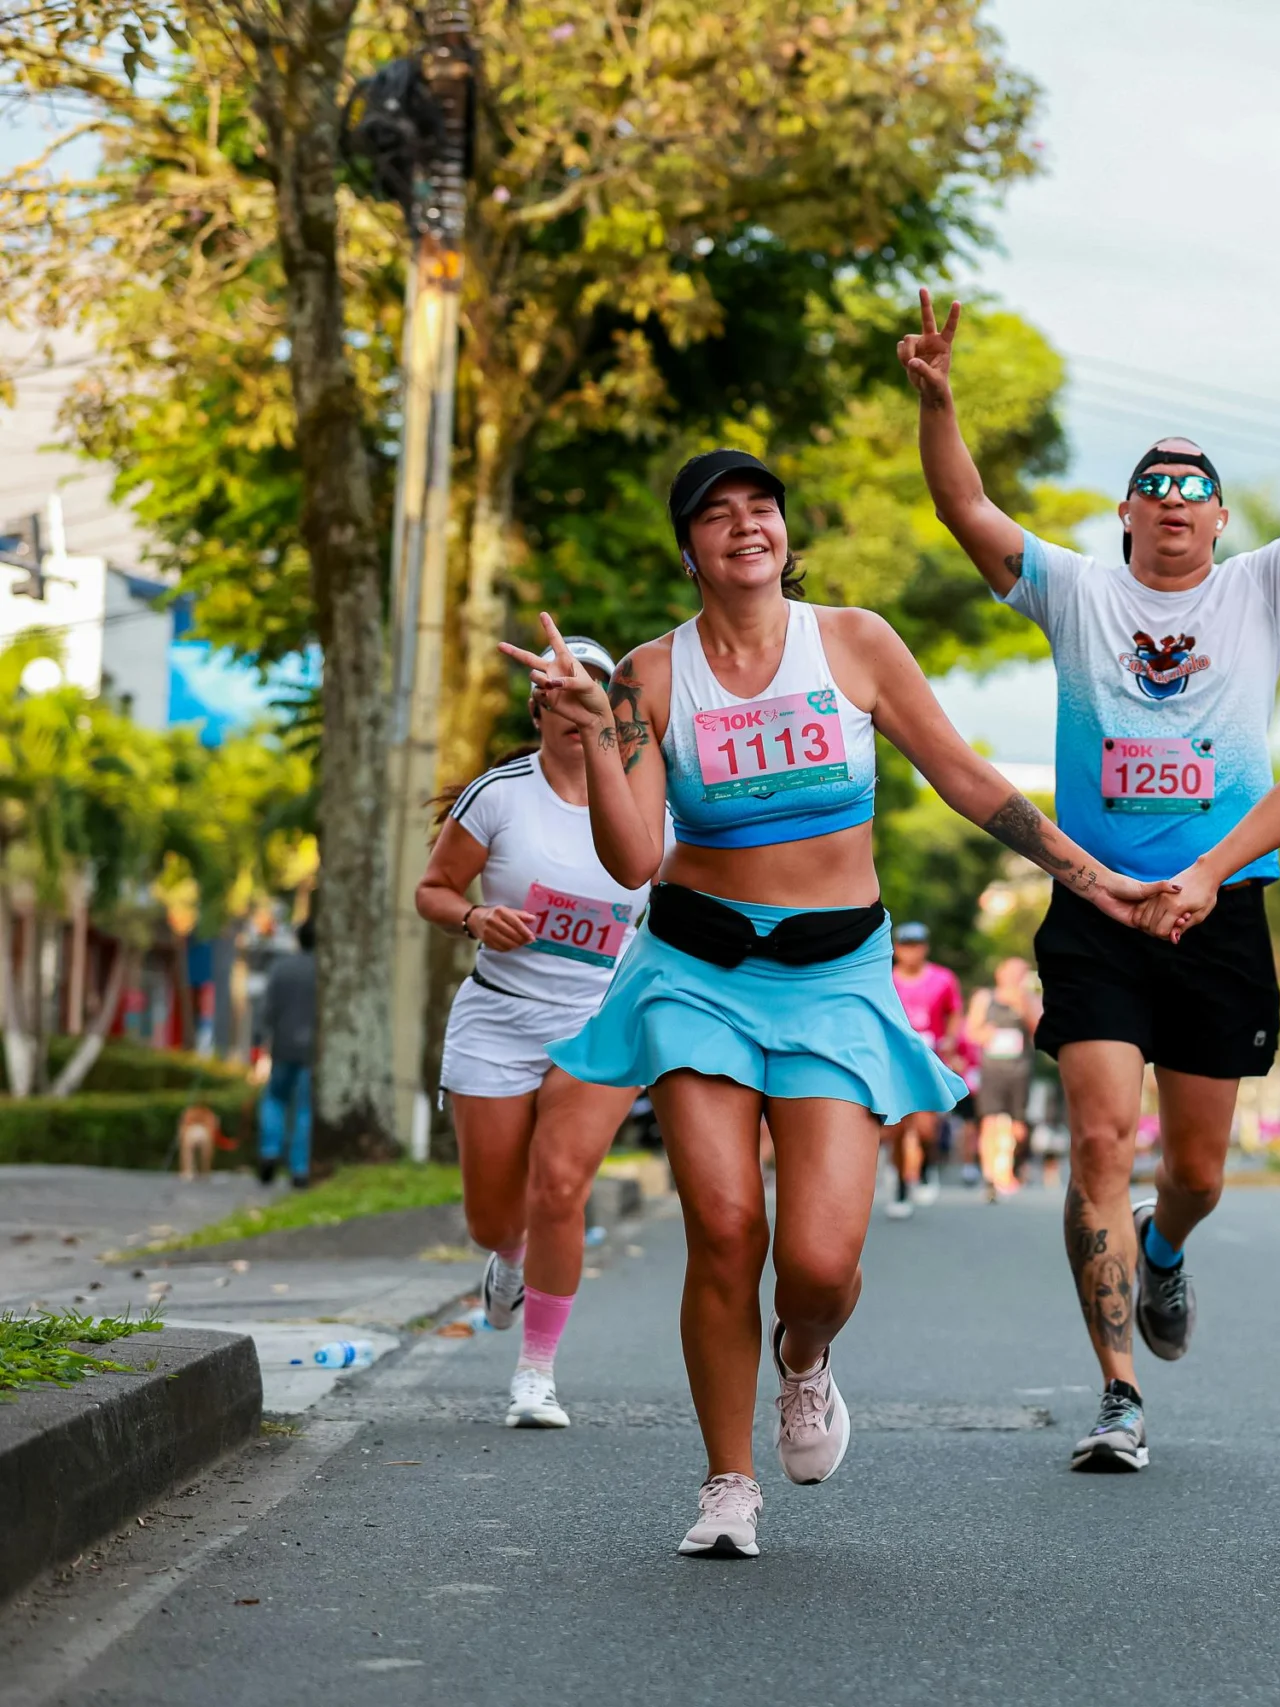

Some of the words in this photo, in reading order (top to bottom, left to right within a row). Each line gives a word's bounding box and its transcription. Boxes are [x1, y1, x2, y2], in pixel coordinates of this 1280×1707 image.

[720, 710, 764, 731] 10K
[718, 723, 829, 775] 1113
[1121, 745, 1153, 757] 10K
[1115, 763, 1202, 794] 1250
[547, 894, 578, 911] 10K
[535, 910, 611, 950] 1301
